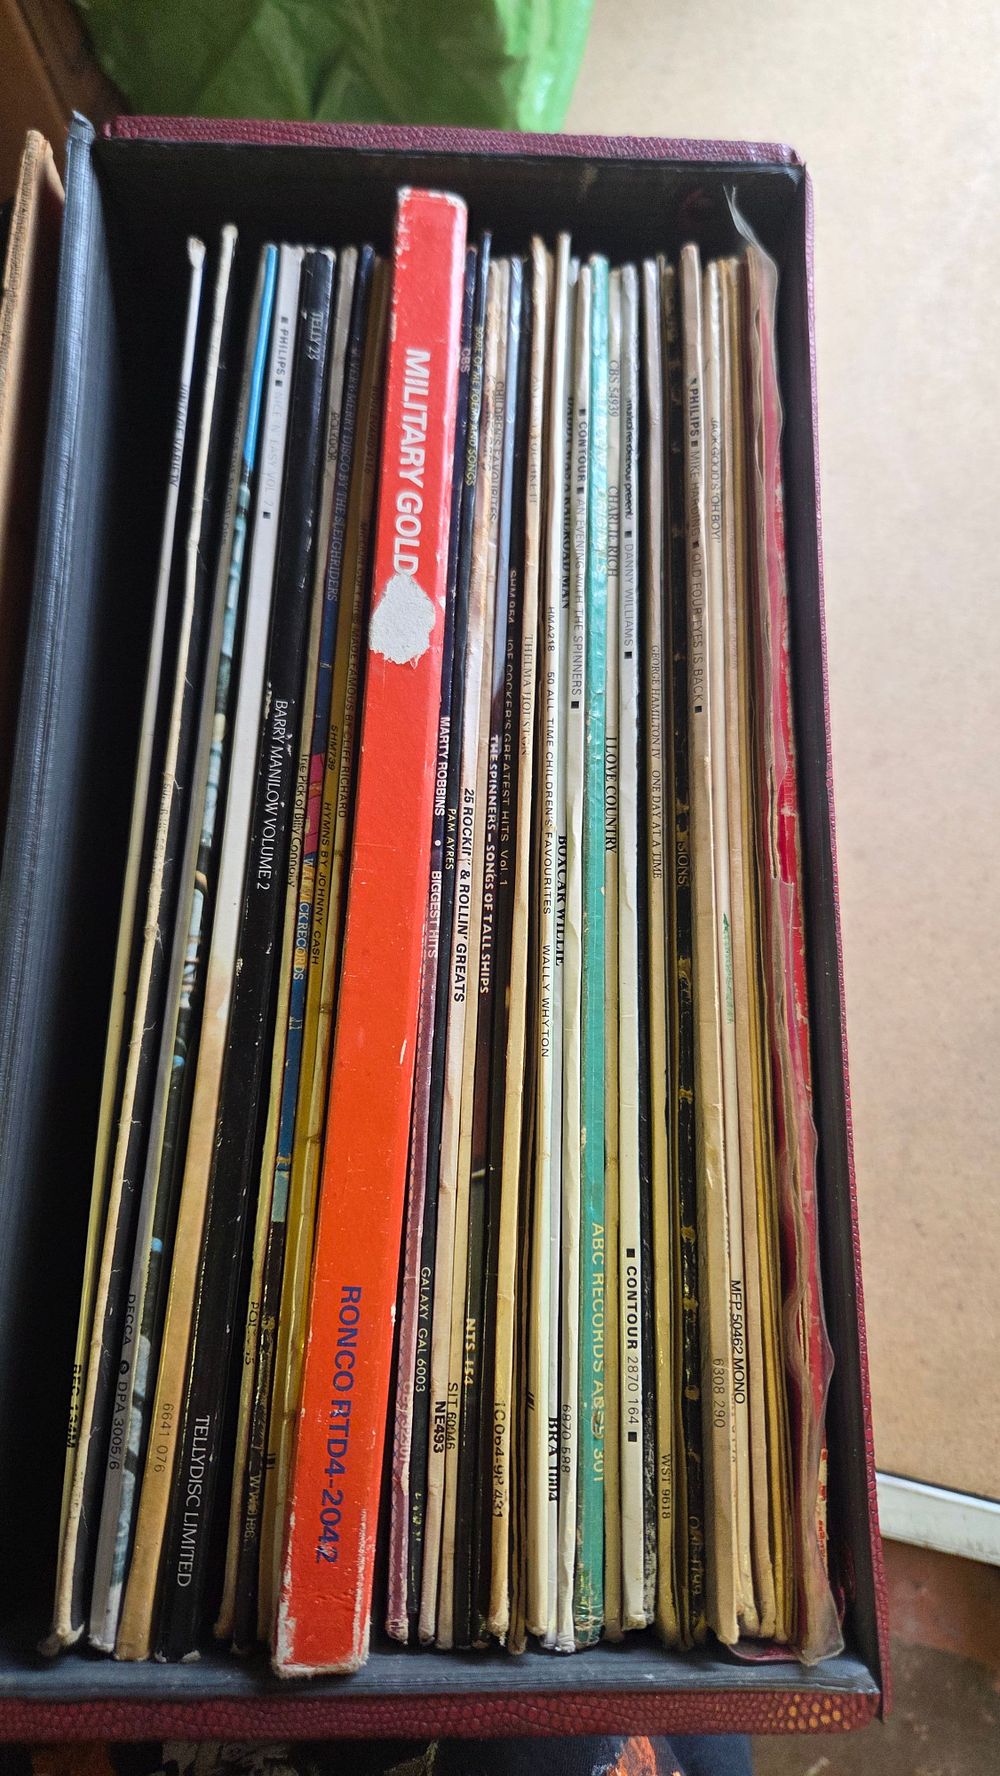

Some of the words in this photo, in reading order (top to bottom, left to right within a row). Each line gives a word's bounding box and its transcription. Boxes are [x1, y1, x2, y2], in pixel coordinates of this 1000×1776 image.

[308, 311, 323, 344] TELLY
[274, 328, 290, 376] PHILIPS
[306, 345, 320, 361] 23
[459, 347, 471, 373] CBS
[472, 355, 481, 369] OF
[608, 359, 619, 384] CBS
[342, 392, 357, 434] MERRY
[397, 348, 433, 488] MILITARY
[607, 386, 619, 417] 54939
[689, 388, 699, 437] PHILIPS
[710, 417, 719, 446] JACK
[167, 437, 183, 487] VARIETY
[338, 434, 353, 472] DISCO
[464, 447, 476, 486] SONGS
[576, 421, 587, 482] CONTOUR
[689, 450, 700, 478] MIKE
[336, 474, 349, 489] BY
[334, 492, 347, 515] THE
[575, 498, 585, 516] AN
[606, 485, 618, 541] CHARLIE
[690, 481, 701, 536] HARDING
[391, 490, 424, 576] GOLD
[574, 520, 585, 569] EVENING
[325, 515, 345, 602] SLEIGHRIDERS
[606, 545, 618, 577] RICH
[623, 543, 633, 584] DANNY
[691, 552, 702, 577] OLD
[560, 575, 569, 609] MAN
[574, 573, 584, 604] WITH
[691, 582, 702, 616] FOUR
[546, 606, 555, 652] HMA218
[572, 609, 583, 632] THE
[623, 588, 634, 646] WILLIAMS
[692, 620, 703, 650] EYES
[349, 629, 360, 661] MADE
[522, 633, 534, 688] THELMA
[693, 653, 703, 664] IS
[546, 670, 554, 687] 50
[571, 635, 582, 696] SPINNERS
[650, 644, 660, 685] GEORGE
[345, 662, 357, 711] FAMOUS
[546, 689, 554, 713] ALL
[693, 668, 703, 701] BACK
[271, 699, 288, 744] BARRY
[545, 717, 554, 747] TIME
[650, 687, 660, 746] HAMILTON
[326, 724, 338, 771] SHM739
[437, 715, 450, 759] MARTY
[489, 734, 498, 761] THE
[651, 747, 660, 759] IV
[263, 745, 283, 816] MANILOW
[501, 733, 511, 805] GREATEST
[604, 745, 617, 782] LOVE
[651, 769, 660, 793] ONE
[294, 798, 305, 810] of
[296, 774, 307, 797] Pick
[337, 765, 350, 818] RICHARD
[433, 761, 447, 816] ROBBINS
[463, 788, 474, 803] 25
[486, 763, 498, 831] SPINNERS
[544, 751, 554, 827] CHILDREN'S
[320, 801, 332, 846] HYMNS
[446, 807, 456, 832] PAM
[500, 810, 509, 841] HITS
[603, 785, 617, 853] COUNTRY
[651, 795, 661, 819] DAY
[651, 821, 661, 837] AT
[651, 839, 661, 848] A
[257, 817, 277, 880] VOLUME
[319, 850, 328, 868] BY
[444, 836, 455, 871] AYRES
[483, 844, 495, 890] SONGS
[651, 850, 661, 879] TIME
[256, 881, 270, 891] 2
[459, 869, 470, 879] &
[542, 831, 552, 914] FAVOURITES
[556, 834, 566, 904] BOXCAR
[297, 857, 314, 921] WARWICK
[313, 871, 327, 925] JOHNNY
[428, 870, 442, 926] BIGGEST
[483, 892, 493, 912] OF
[457, 884, 469, 939] ROLLIN'
[310, 929, 322, 966] CASH
[427, 929, 439, 959] HITS
[481, 913, 492, 951] TALL
[555, 907, 565, 967] WILLIE
[292, 922, 309, 981] RECORDS
[541, 944, 550, 992] WALLY
[452, 942, 467, 1003] GREATS
[479, 953, 490, 993] SHIPS
[540, 997, 549, 1057] WHYTON
[591, 1222, 604, 1265] ABC
[417, 1266, 431, 1319] GALAXY
[626, 1265, 638, 1350] CONTOUR
[730, 1279, 741, 1311] MFP
[122, 1293, 137, 1346] DECCA
[332, 1284, 362, 1392] RONCO
[464, 1317, 476, 1352] NTS
[591, 1272, 604, 1373] RECORDS
[731, 1312, 743, 1354] 50462
[416, 1327, 428, 1355] GAL
[414, 1357, 426, 1393] 6003
[463, 1359, 474, 1386] 154
[626, 1355, 639, 1392] 2870
[711, 1357, 725, 1395] 6308
[733, 1357, 745, 1404] MONO
[113, 1380, 128, 1414] DPA
[446, 1382, 458, 1407] SIT
[627, 1397, 639, 1425] 164
[712, 1399, 726, 1428] 290
[157, 1402, 174, 1437] 6641
[432, 1400, 446, 1453] NE493
[444, 1411, 456, 1450] 60046
[547, 1416, 557, 1456] BRA
[561, 1403, 571, 1439] 6870
[107, 1417, 124, 1471] 3005/6
[152, 1443, 169, 1475] 076
[184, 1413, 210, 1508] TELLYDISC
[560, 1446, 571, 1473] 588
[314, 1397, 352, 1565] RTD4-2042
[592, 1448, 604, 1482] 301
[660, 1453, 670, 1484] WST
[661, 1488, 671, 1519] 9618
[175, 1511, 199, 1588] LIMITED
